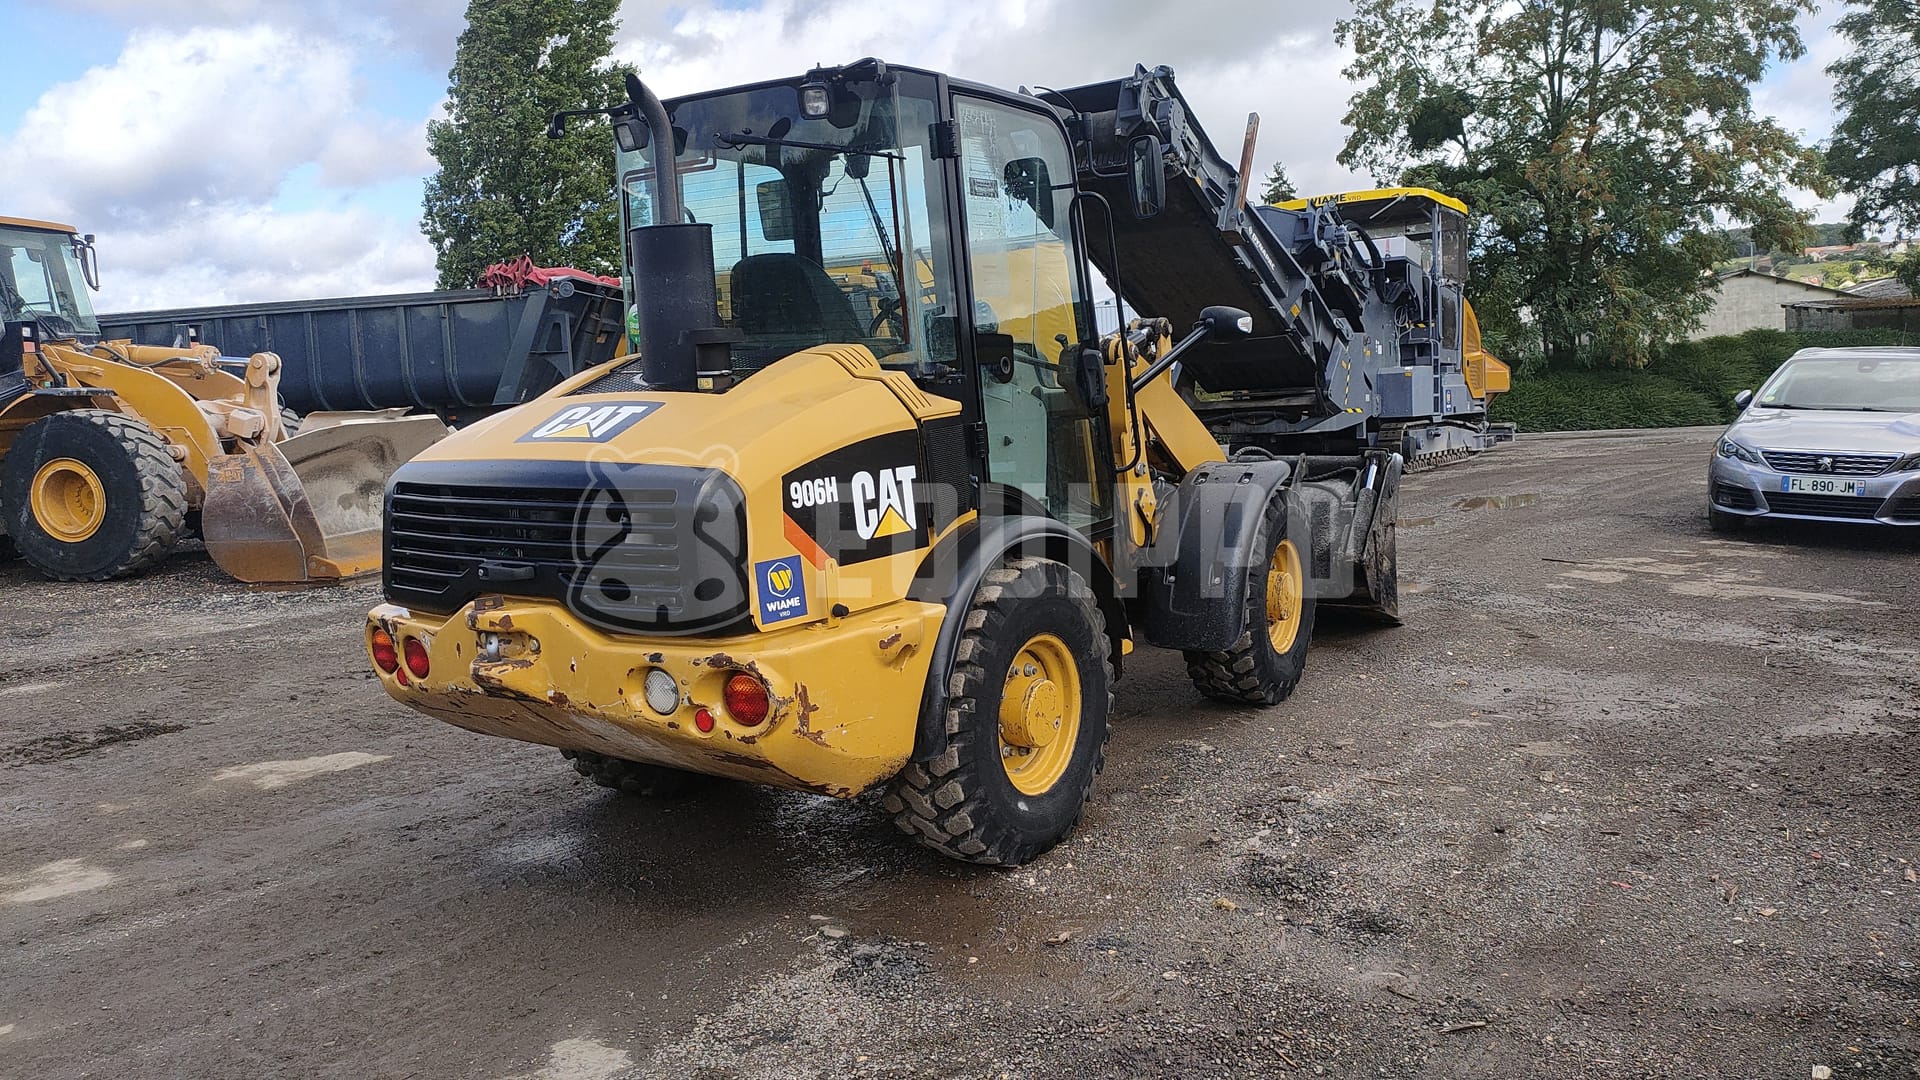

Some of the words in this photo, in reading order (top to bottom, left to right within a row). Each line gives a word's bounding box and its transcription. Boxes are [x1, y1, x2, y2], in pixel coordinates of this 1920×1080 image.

[532, 405, 649, 438] CAT
[790, 476, 839, 509] 906H
[851, 465, 917, 540] CAT
[766, 596, 800, 612] WIAME
